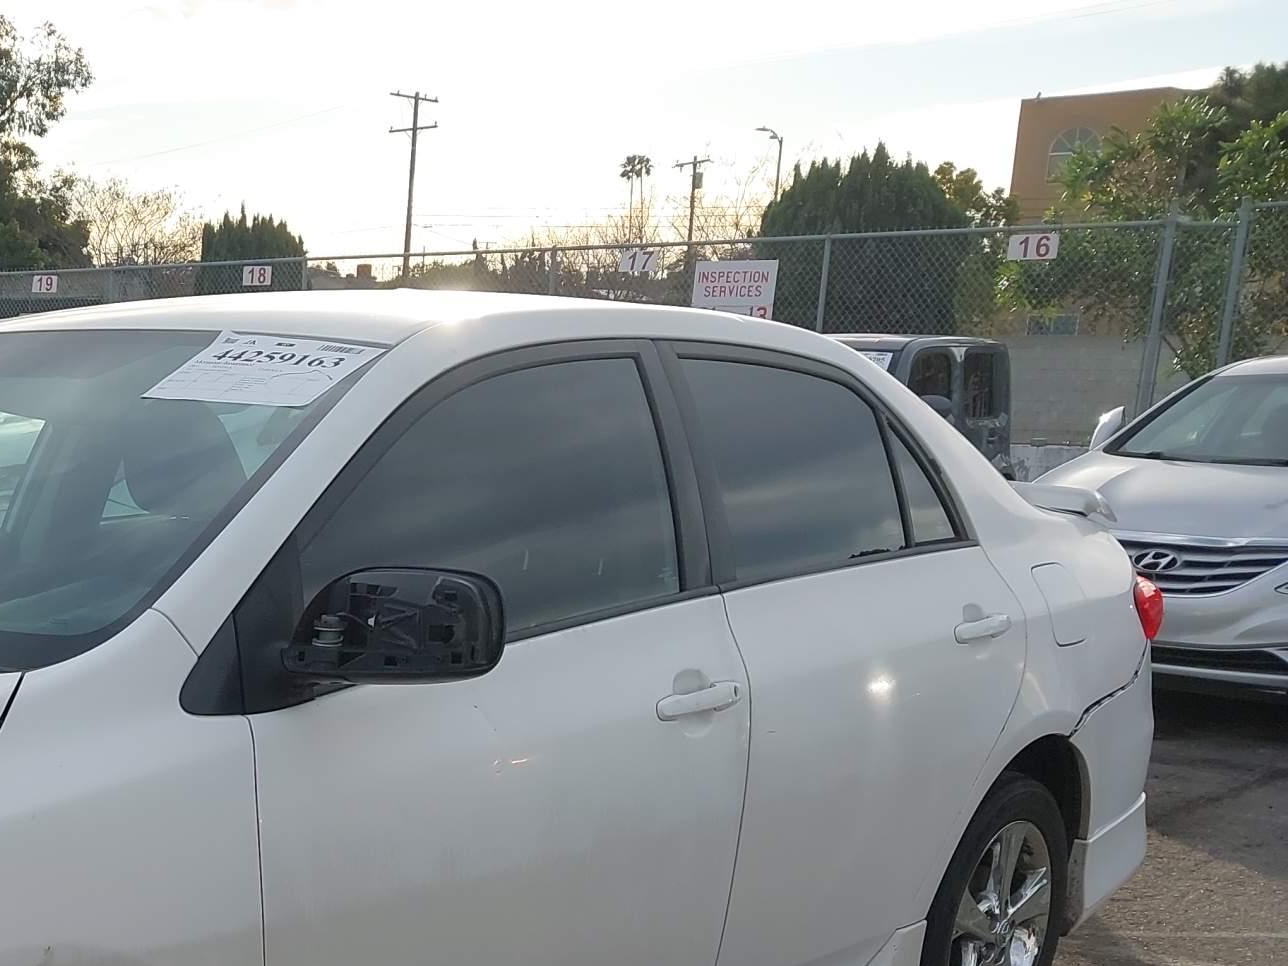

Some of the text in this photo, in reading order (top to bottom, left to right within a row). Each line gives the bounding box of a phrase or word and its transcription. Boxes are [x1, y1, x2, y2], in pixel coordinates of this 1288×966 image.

[1018, 235, 1050, 258] 16
[628, 250, 654, 271] 17
[37, 276, 53, 291] 19
[248, 266, 266, 284] 18
[697, 271, 770, 284] INSPECTION
[703, 285, 763, 298] SERVICES
[212, 348, 346, 369] 44259163
